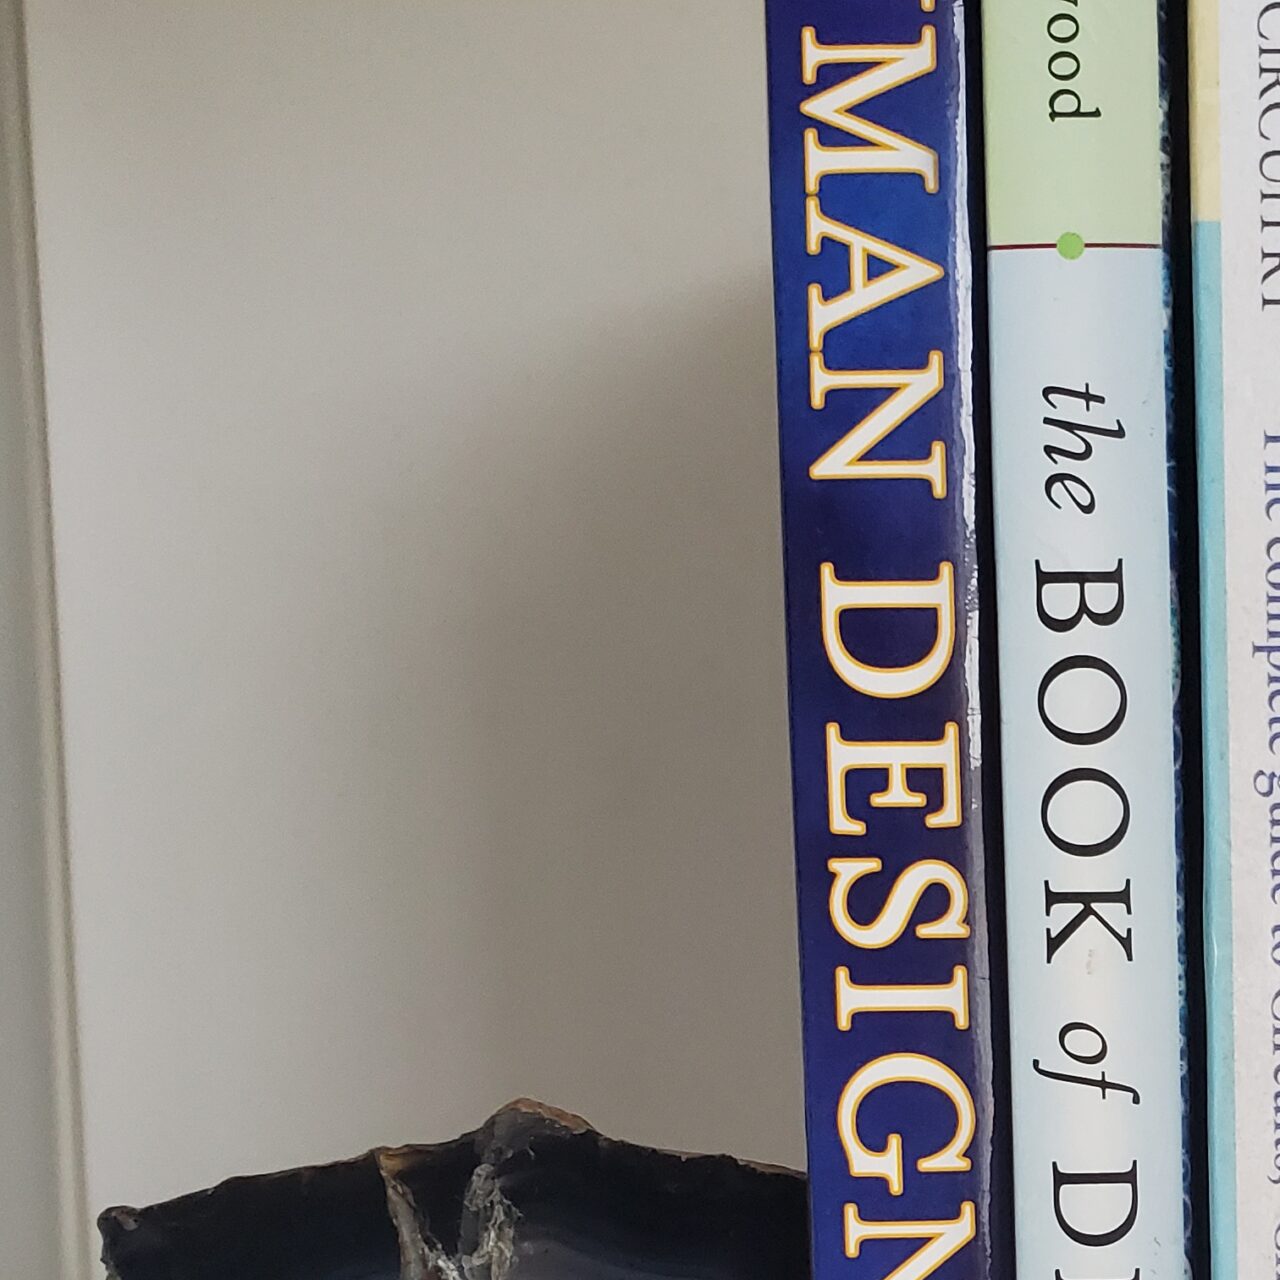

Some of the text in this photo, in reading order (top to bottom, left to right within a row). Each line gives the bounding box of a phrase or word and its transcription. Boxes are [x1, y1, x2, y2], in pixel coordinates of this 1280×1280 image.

[800, 0, 947, 499] MAN
[1041, 382, 1127, 515] the
[1034, 557, 1134, 965] BOOK
[1032, 1021, 1141, 1106] of
